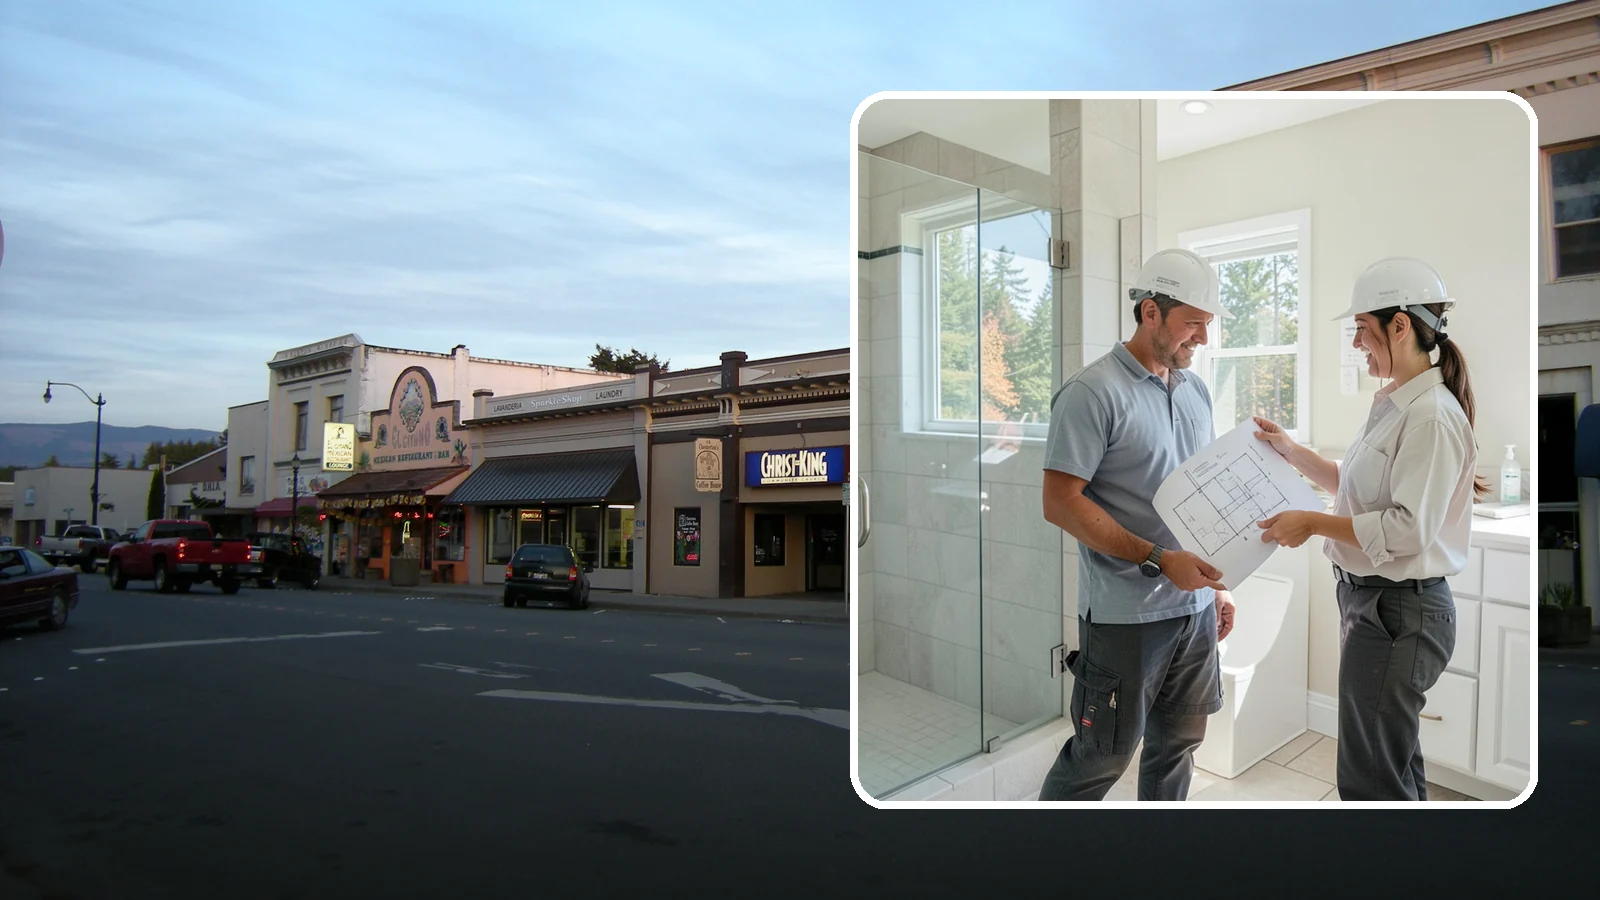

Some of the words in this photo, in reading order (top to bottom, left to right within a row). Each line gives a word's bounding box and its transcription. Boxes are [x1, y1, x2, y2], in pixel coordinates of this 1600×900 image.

[530, 398, 561, 409] Sparkle
[561, 394, 583, 406] Shop
[595, 388, 623, 400] LAUNDRY
[493, 402, 523, 413] LAVANDERIA
[391, 425, 402, 449] EL
[373, 454, 396, 464] MEXICAN
[397, 451, 434, 463] RESTAURANT
[437, 449, 450, 459] BAR
[761, 452, 796, 478] CHRIST
[799, 449, 828, 476] KING
[696, 480, 709, 489] Coffee
